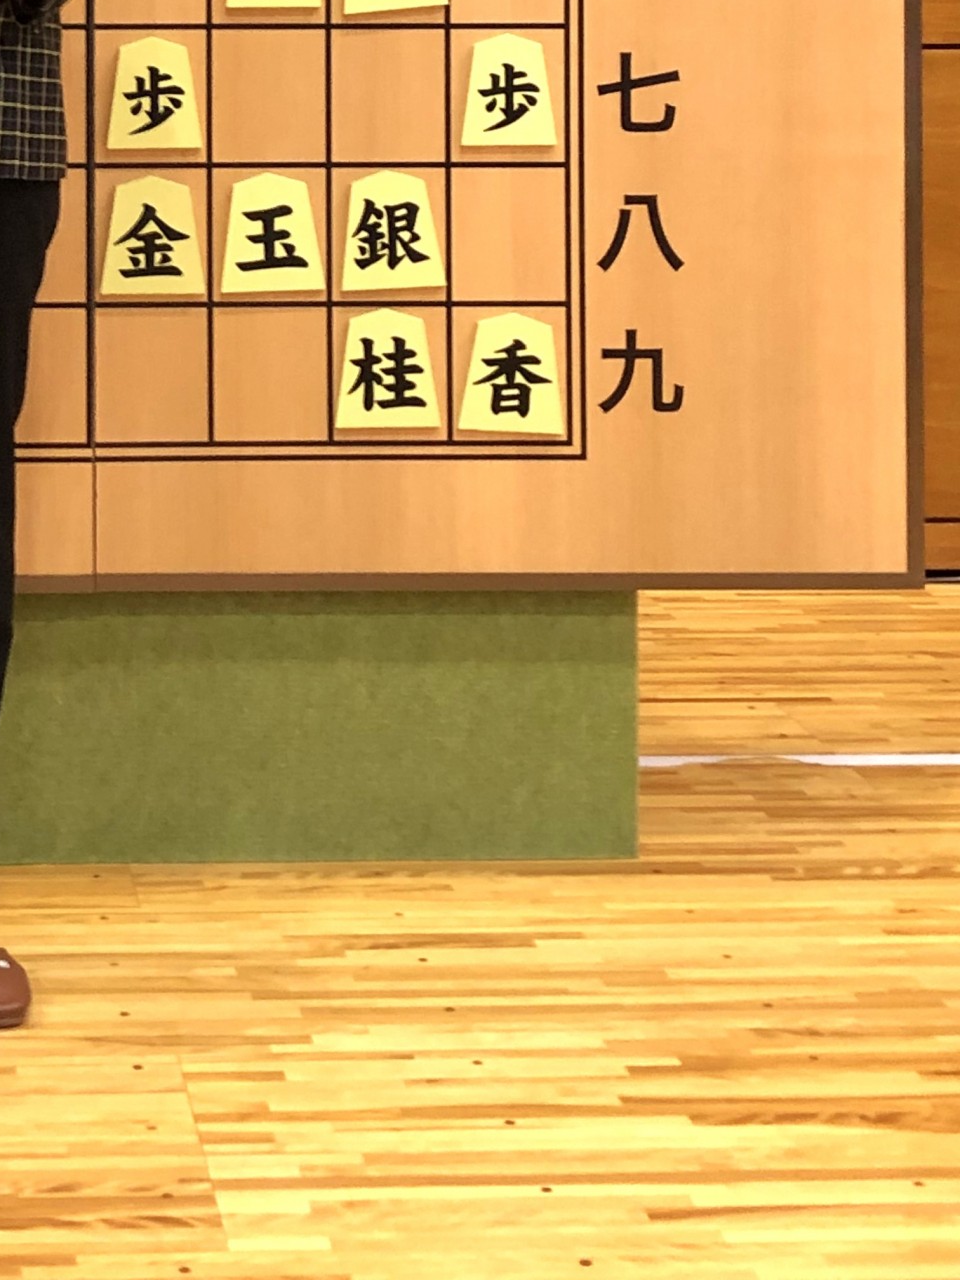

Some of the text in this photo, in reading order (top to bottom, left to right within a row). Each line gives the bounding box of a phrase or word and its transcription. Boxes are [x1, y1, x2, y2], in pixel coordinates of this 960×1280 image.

[123, 66, 184, 134] 歩
[478, 64, 539, 131] 歩
[597, 53, 679, 132] 七
[114, 203, 189, 277] 金
[236, 205, 308, 271] 玉
[352, 199, 429, 270] 銀
[597, 195, 684, 271] 八
[349, 337, 426, 411] 桂
[474, 340, 551, 417] 香
[598, 329, 684, 413] 九
